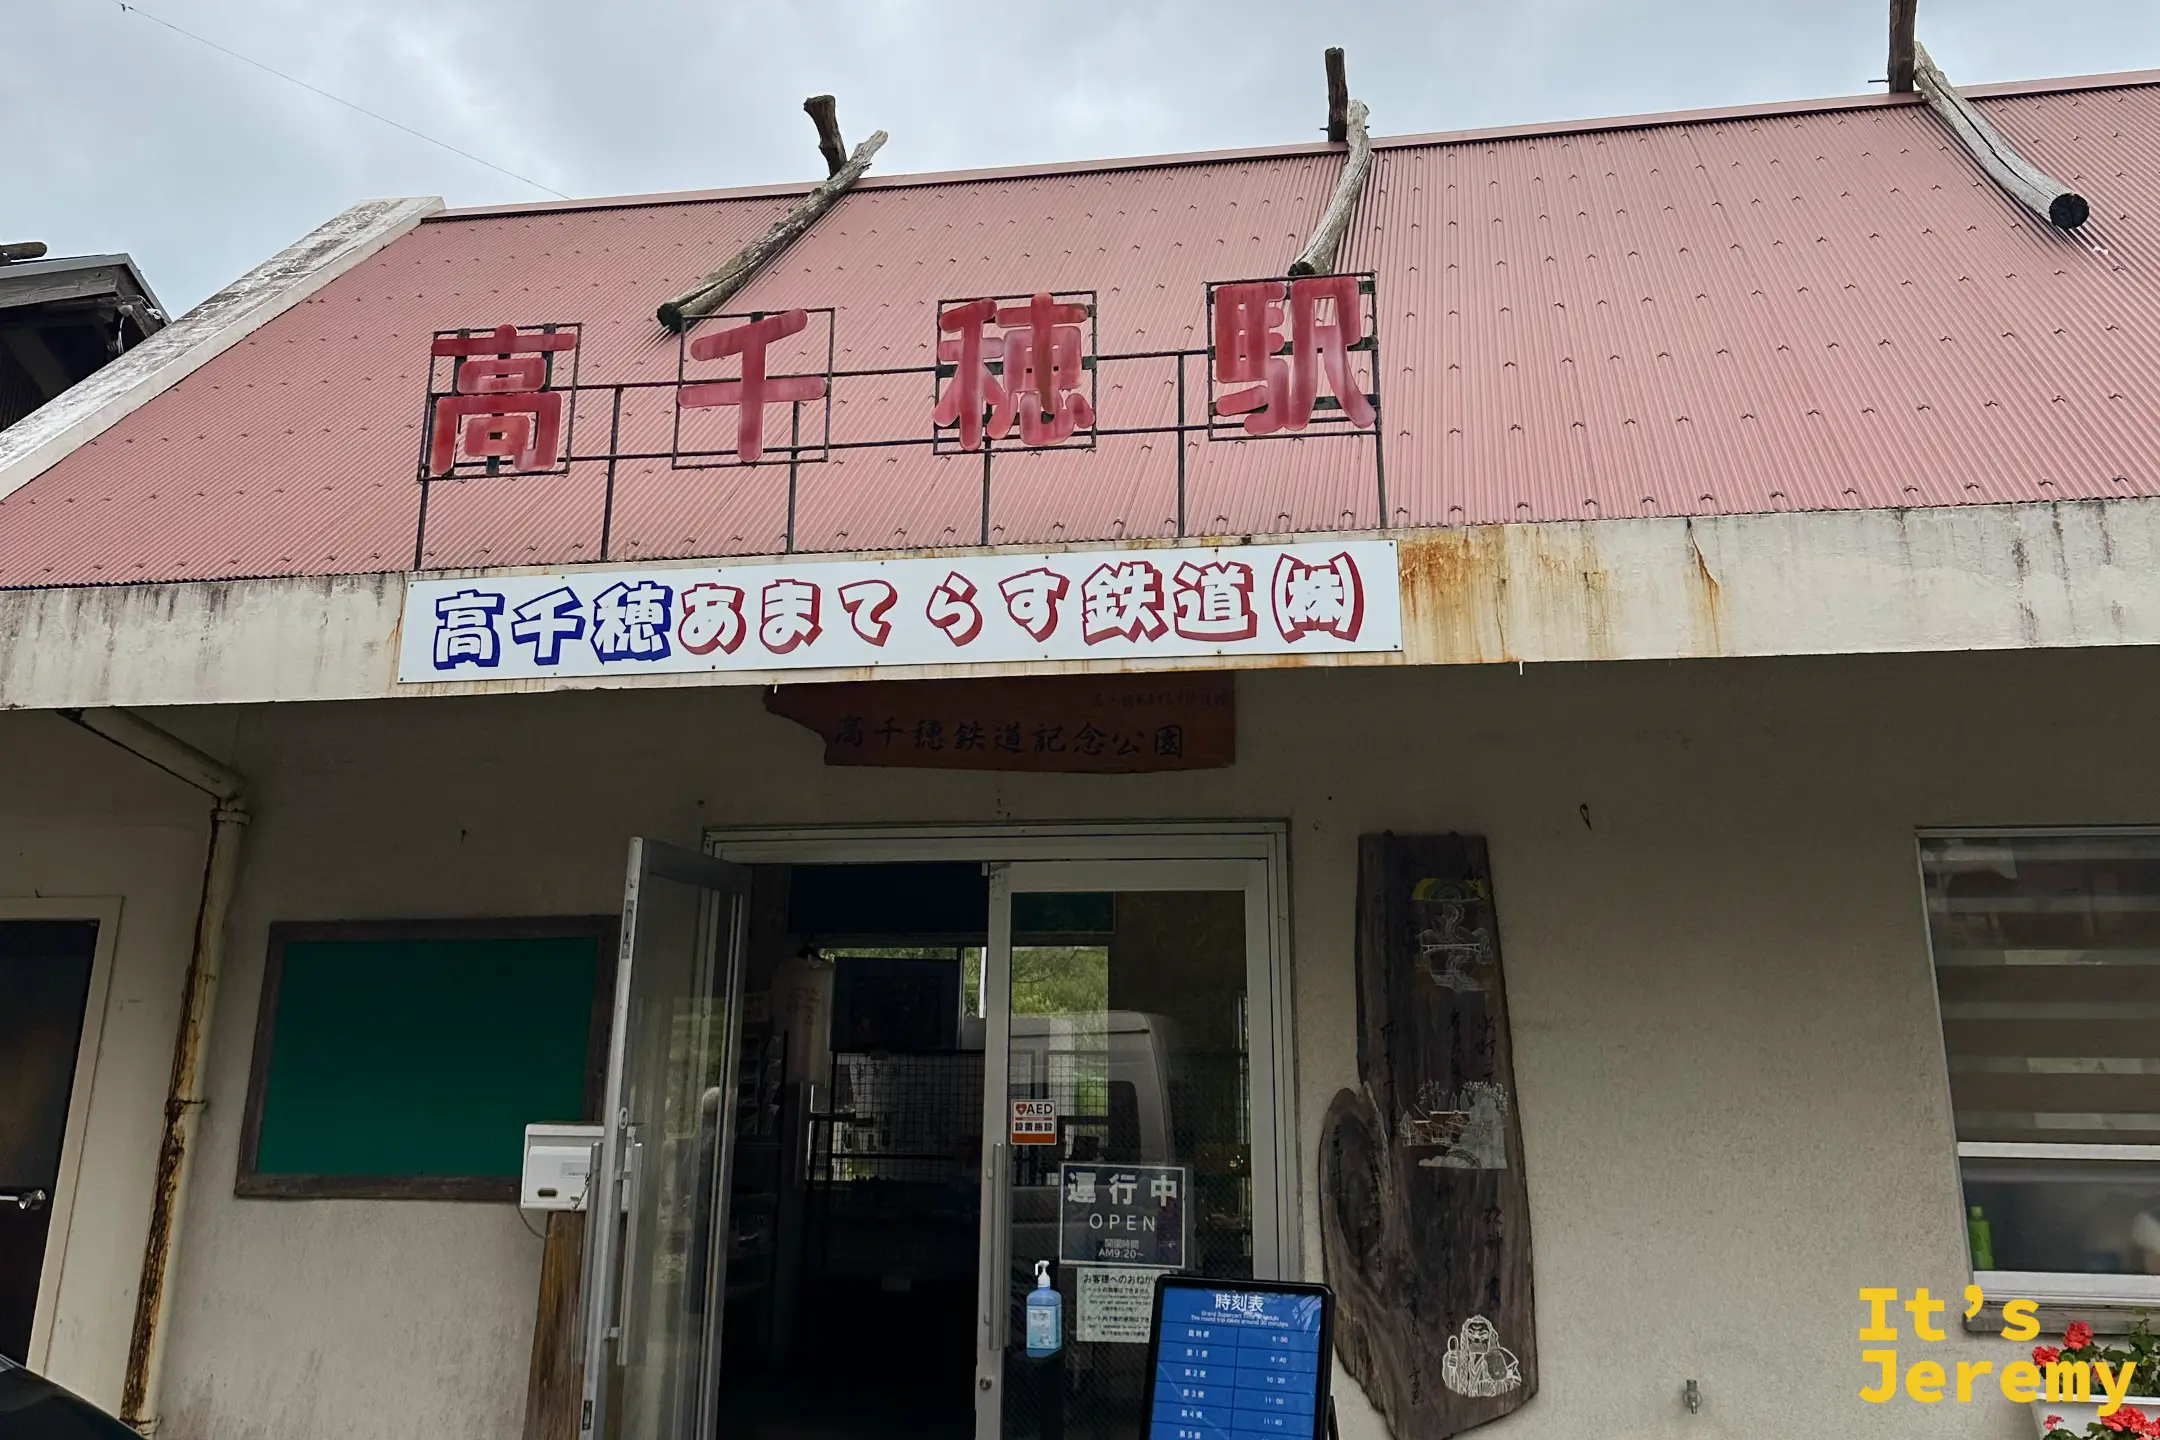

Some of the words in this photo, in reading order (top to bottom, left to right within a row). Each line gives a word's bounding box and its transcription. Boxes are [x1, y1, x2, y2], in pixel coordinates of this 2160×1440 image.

[430, 275, 1377, 477] 高千穂駅
[833, 713, 1184, 760] 高千穂鉄道記念公園
[1027, 1103, 1053, 1115] AED
[1067, 1172, 1177, 1207] 運行中
[1089, 1213, 1156, 1232] OPEN
[1214, 1293, 1265, 1313] 時刻表
